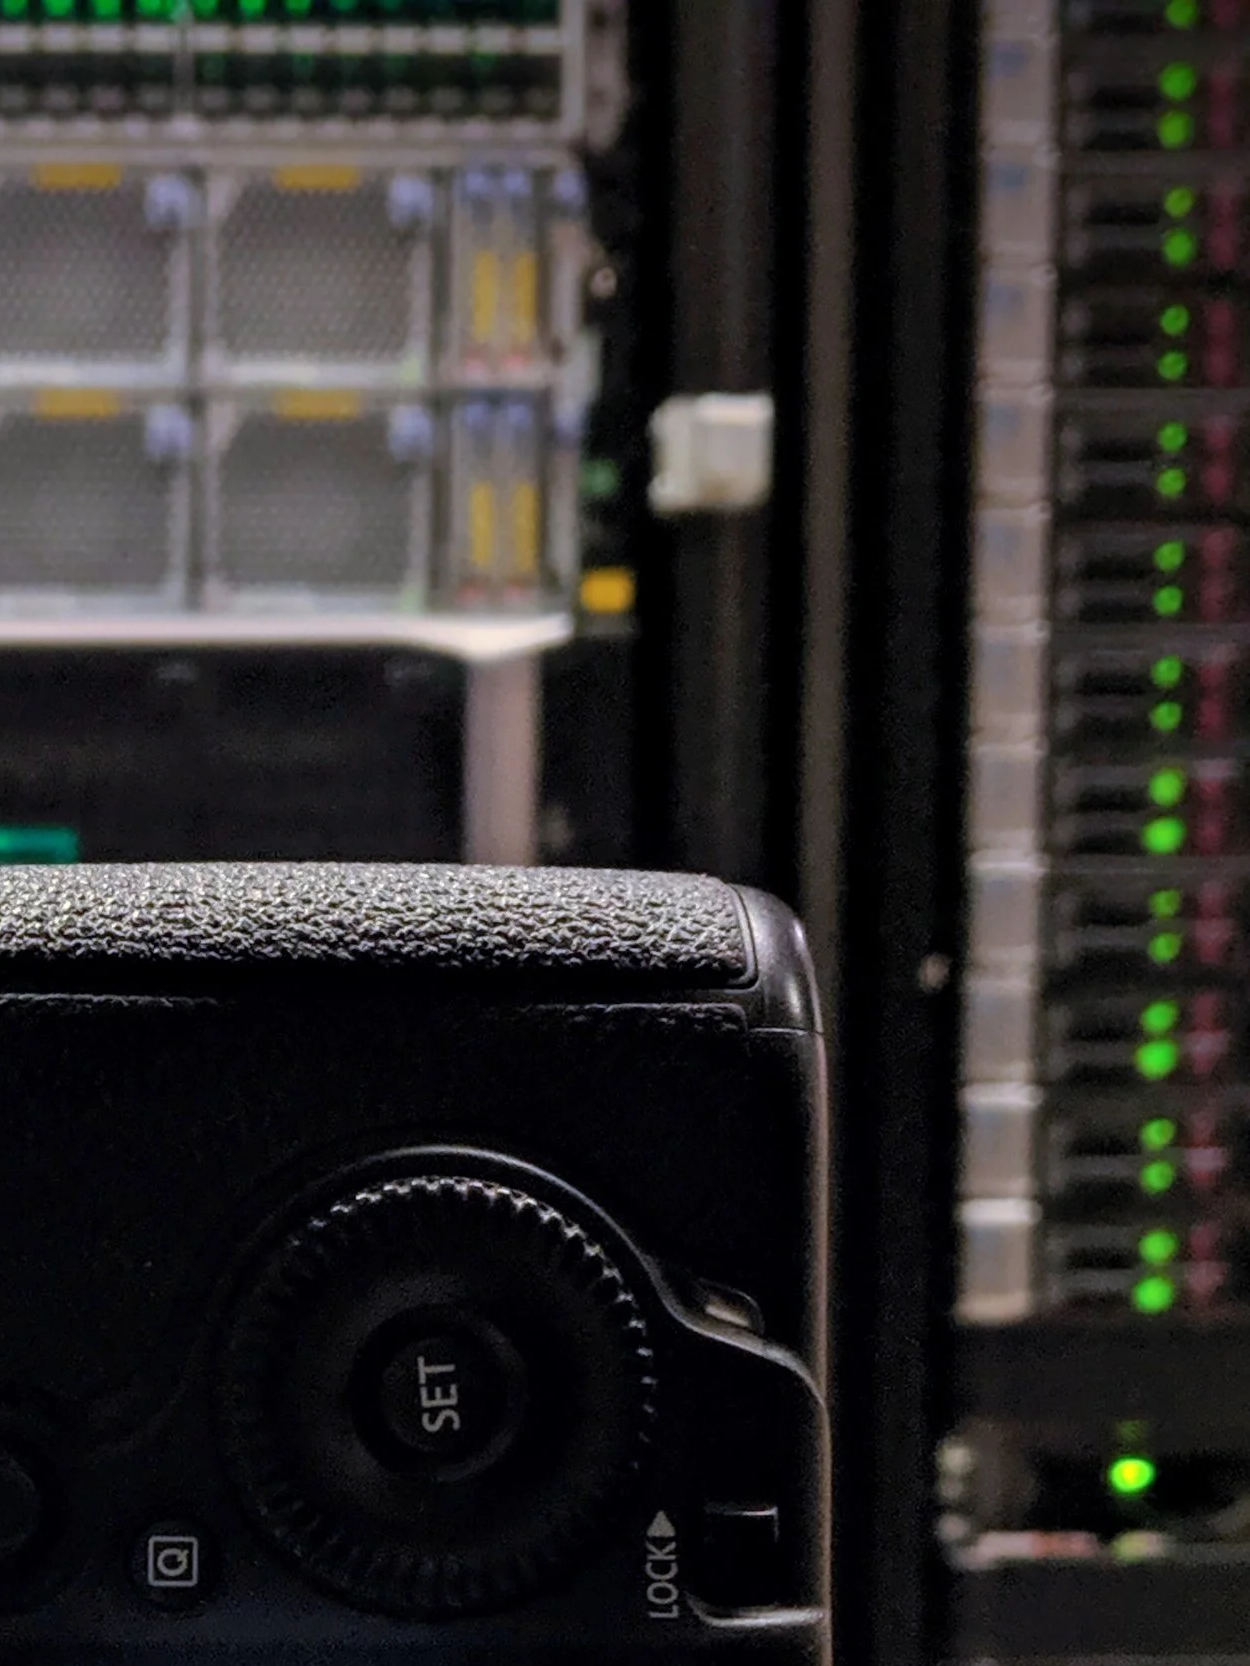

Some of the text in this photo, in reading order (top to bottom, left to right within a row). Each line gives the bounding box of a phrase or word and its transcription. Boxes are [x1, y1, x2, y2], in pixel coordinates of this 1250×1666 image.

[417, 1356, 461, 1433] SET
[156, 1547, 189, 1577] Q
[646, 1541, 679, 1619] LOCK
